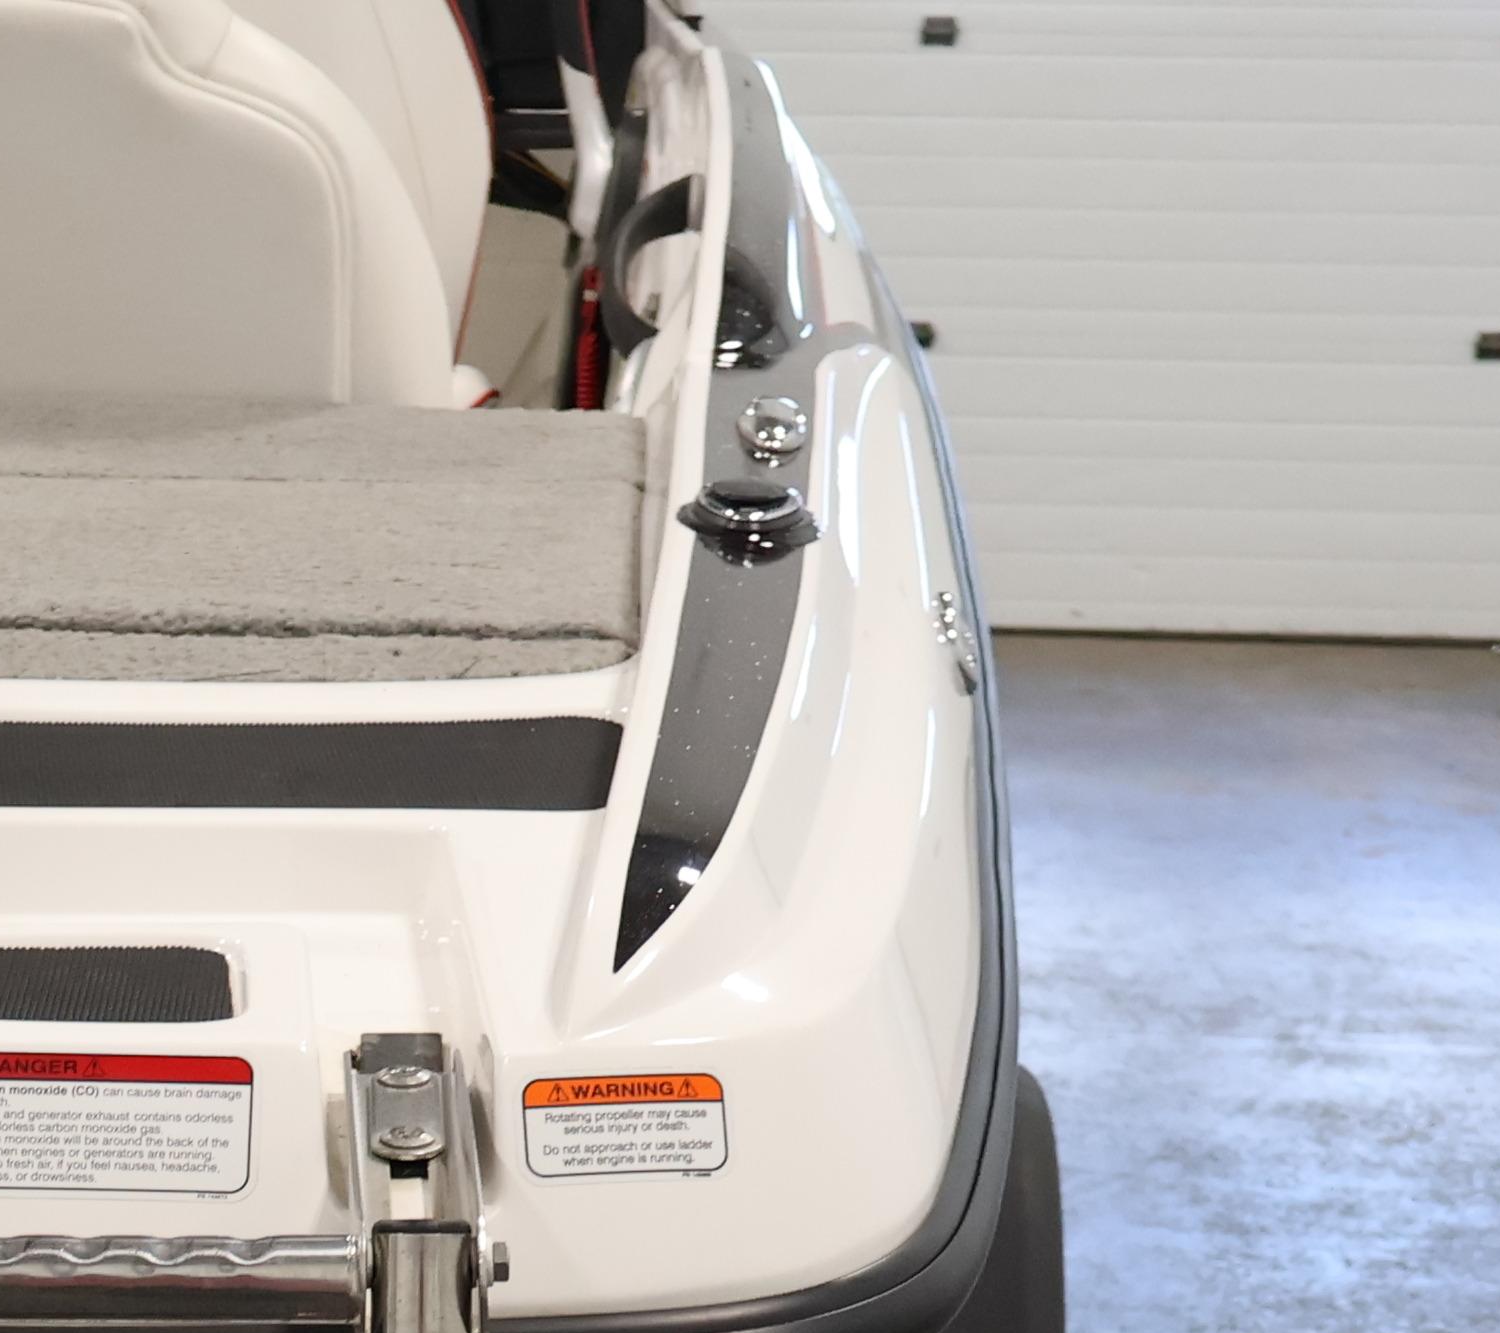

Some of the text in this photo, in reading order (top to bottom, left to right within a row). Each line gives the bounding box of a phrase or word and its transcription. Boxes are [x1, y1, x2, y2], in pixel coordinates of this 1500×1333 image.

[9, 1085, 67, 1096] monoxide
[72, 1085, 99, 1098] (CO)
[103, 1088, 124, 1097] can
[127, 1089, 161, 1098] cause
[164, 1088, 192, 1099] brain
[196, 1088, 243, 1101] damage
[570, 1081, 674, 1099] WARNING
[4, 1110, 25, 1119] and
[28, 1111, 83, 1122] generator
[86, 1110, 130, 1121] exhaust
[134, 1112, 182, 1122] contains
[185, 1112, 233, 1123] odorless
[545, 1109, 707, 1123] Rotating propeller may cause
[38, 1123, 77, 1133] carbon
[81, 1124, 137, 1134] monoxide
[564, 1124, 604, 1135] serious
[608, 1123, 638, 1134] injury
[641, 1122, 652, 1131] or
[4, 1134, 60, 1144] monoxide
[64, 1135, 81, 1144] will
[85, 1135, 98, 1145] be
[102, 1136, 142, 1146] around
[146, 1137, 163, 1146] the
[166, 1137, 193, 1147] back
[197, 1137, 209, 1147] of
[211, 1138, 229, 1148] the
[543, 1139, 712, 1156] Do not approach or use ladder
[21, 1148, 65, 1159] engines
[68, 1148, 80, 1157] or
[84, 1148, 144, 1159] generators
[147, 1151, 165, 1159] are
[563, 1152, 694, 1167] when engine is running.
[6, 1159, 34, 1168] fresh
[37, 1159, 53, 1170] air,
[66, 1160, 87, 1173] you
[91, 1160, 110, 1170] feel
[114, 1161, 157, 1172] nausea,
[161, 1161, 220, 1173] headache,
[16, 1173, 28, 1181] or
[30, 1172, 96, 1183] drowsiness.
